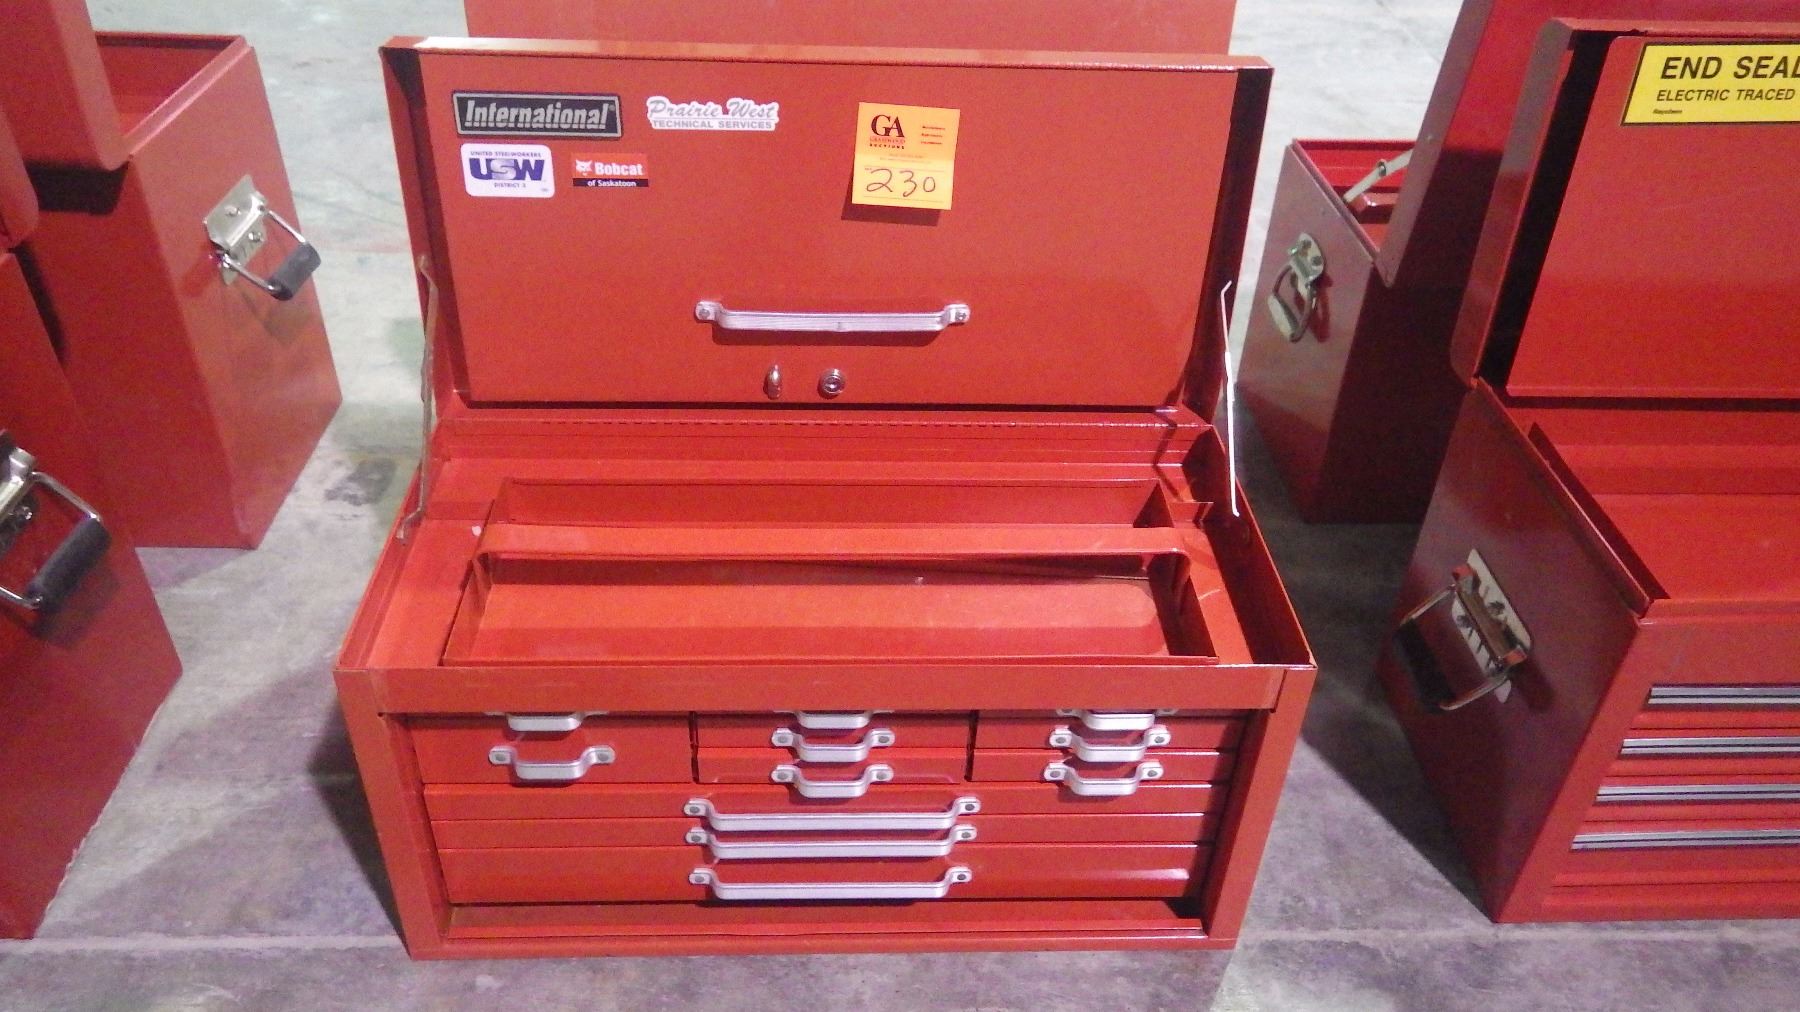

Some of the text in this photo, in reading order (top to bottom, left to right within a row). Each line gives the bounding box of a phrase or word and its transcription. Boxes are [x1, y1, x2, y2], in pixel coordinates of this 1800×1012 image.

[1660, 56, 1722, 79] END
[1656, 88, 1796, 101] ELECTRIC TRACED
[464, 100, 609, 130] International
[649, 99, 775, 118] Prairie West
[652, 119, 772, 129] TECHNICAL SERVICES
[870, 114, 905, 137] GA
[469, 158, 545, 181] USW
[594, 161, 644, 176] Bobcat
[587, 179, 637, 187] of Saskatoon
[866, 168, 936, 197] 230
